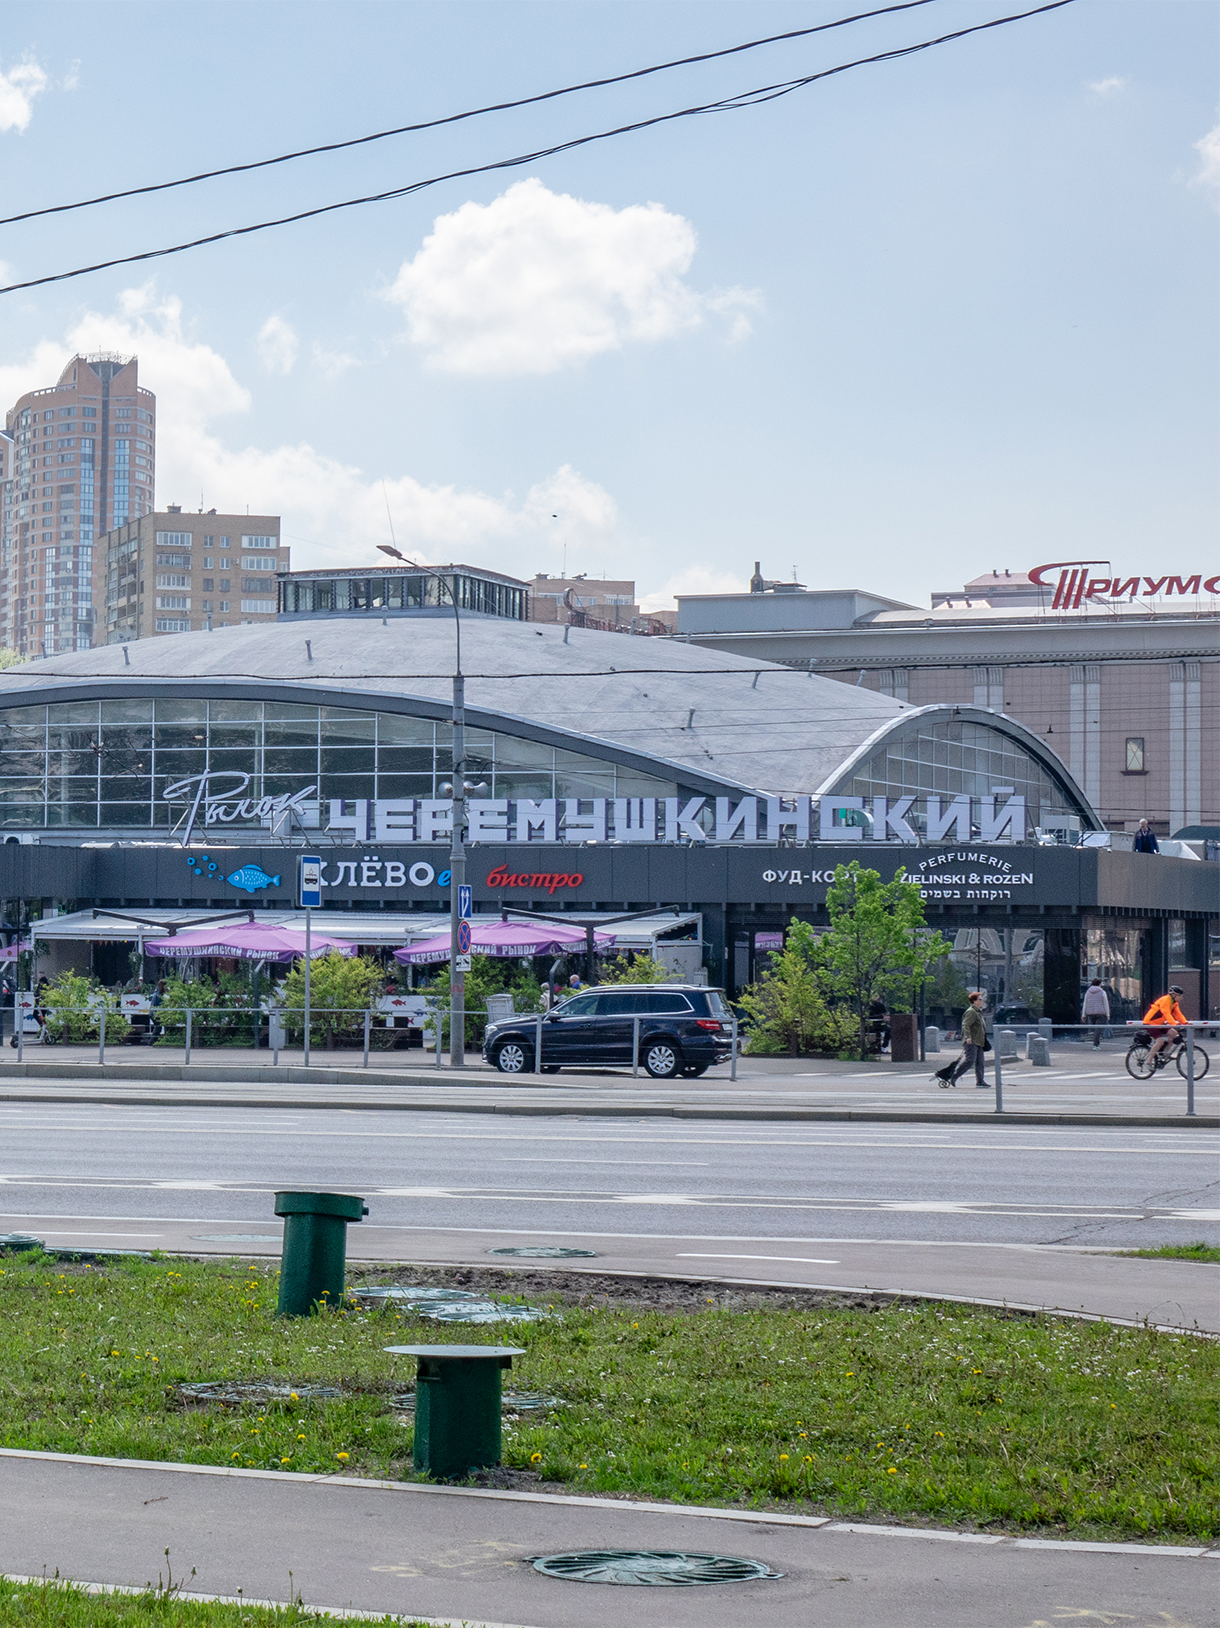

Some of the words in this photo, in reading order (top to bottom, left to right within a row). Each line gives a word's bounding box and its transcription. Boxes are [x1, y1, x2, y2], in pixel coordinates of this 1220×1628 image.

[163, 768, 318, 847] Рынок
[326, 786, 1027, 842] ЧЕРЕМУШКИНСКИЙ
[918, 851, 1013, 873] PERFUMERIE
[486, 864, 584, 894] бистро
[968, 873, 980, 884] &
[983, 872, 1033, 885] ROZEN
[920, 889, 961, 899] בשמים
[246, 949, 279, 960] РЫНОК
[502, 944, 537, 955] РЫНОК
